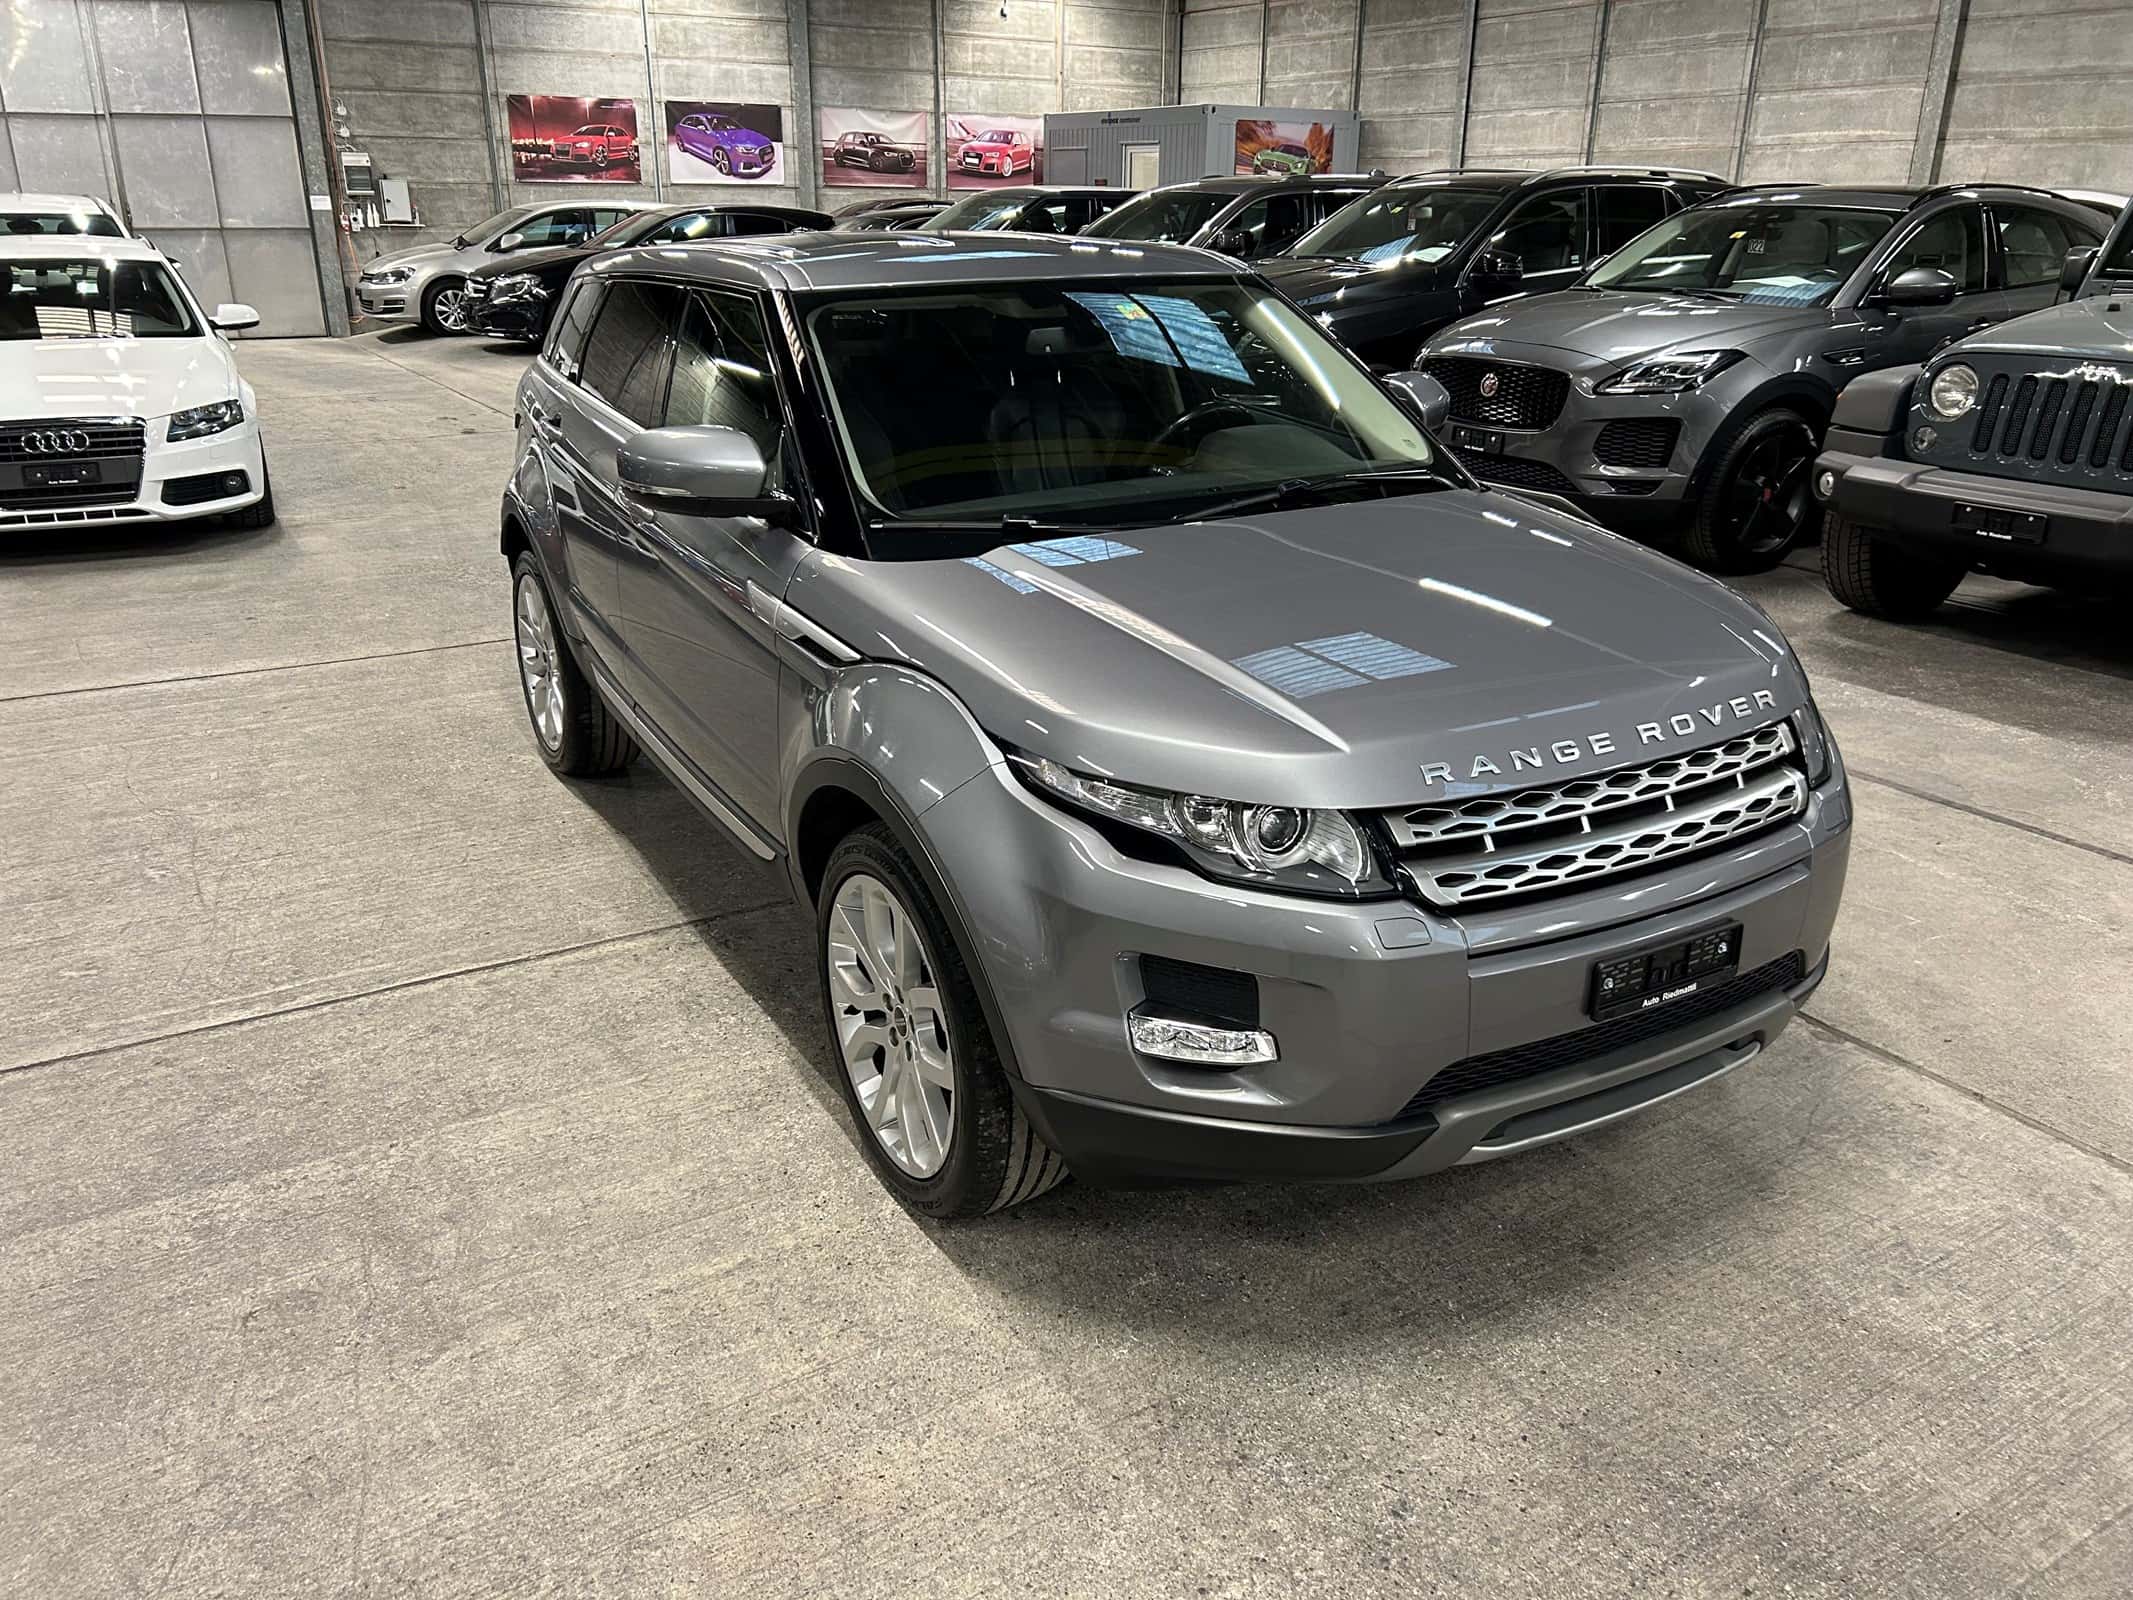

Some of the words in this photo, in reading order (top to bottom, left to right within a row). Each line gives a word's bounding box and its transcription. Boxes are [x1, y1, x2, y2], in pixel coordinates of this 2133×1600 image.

[1419, 732, 1616, 786] RANGE
[1635, 689, 1778, 745] ROVER
[1641, 996, 1660, 1008] Auto
